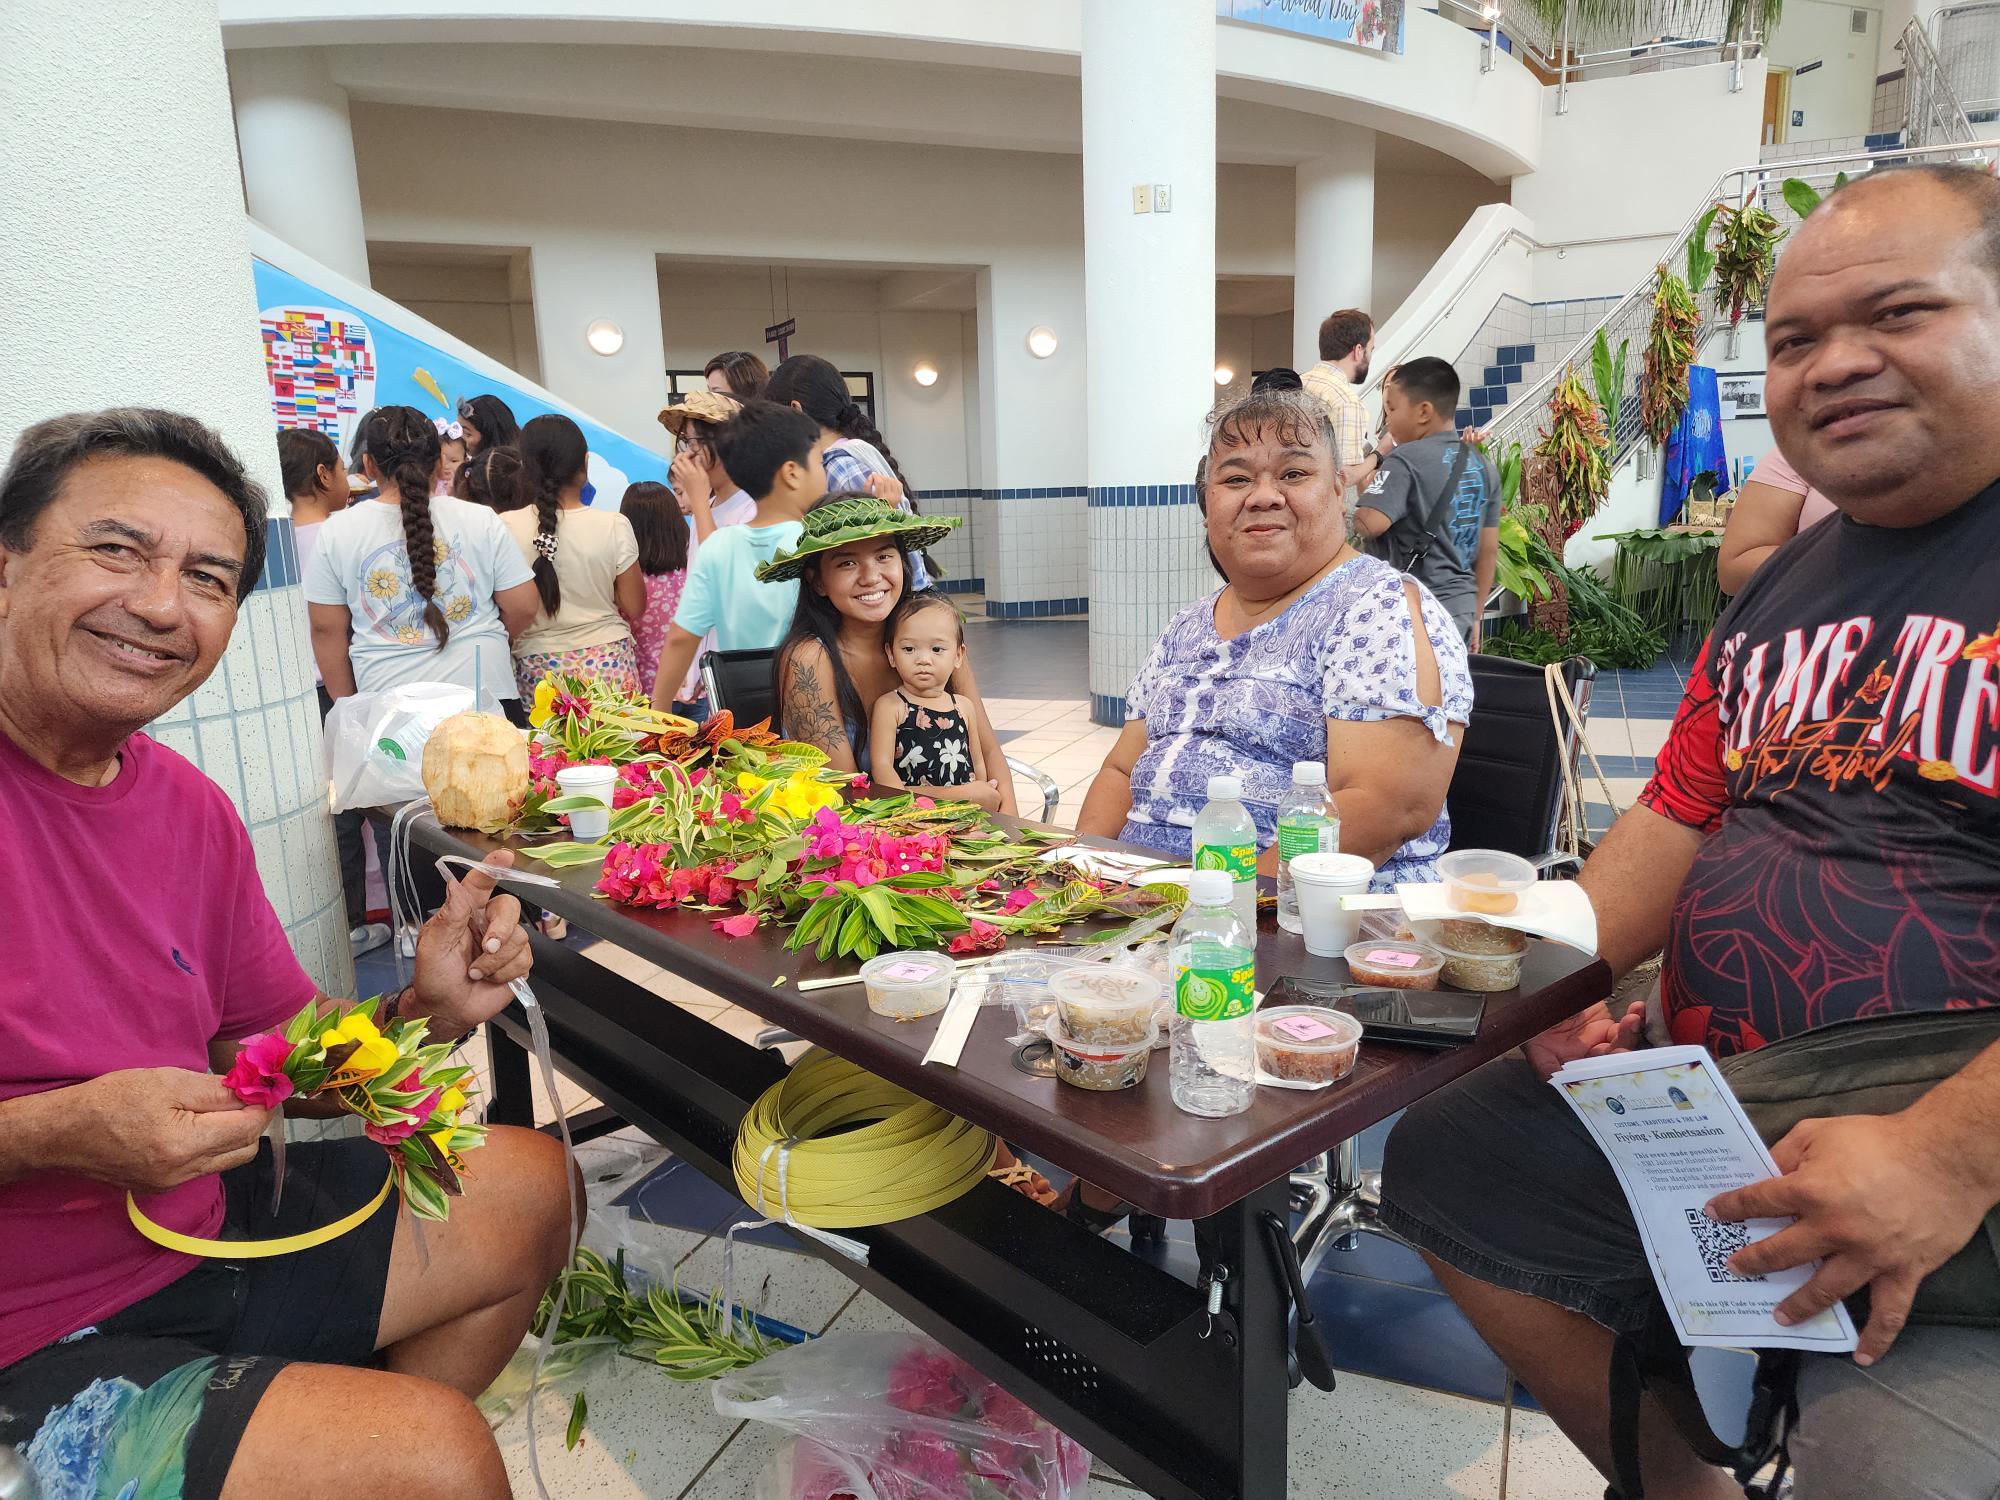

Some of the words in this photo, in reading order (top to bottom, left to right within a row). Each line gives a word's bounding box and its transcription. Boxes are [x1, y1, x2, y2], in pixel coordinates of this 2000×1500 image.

[1642, 1117, 1675, 1127] TRADITIONS
[1682, 1116, 1695, 1124] THE
[1695, 1114, 1709, 1122] LAW
[1651, 1126, 1726, 1141] Kombetsasion
[1634, 1151, 1649, 1160] This
[1650, 1151, 1669, 1159] event
[1689, 1147, 1718, 1158] possible
[1655, 1183, 1668, 1192] Our
[1697, 1182, 1711, 1190] and
